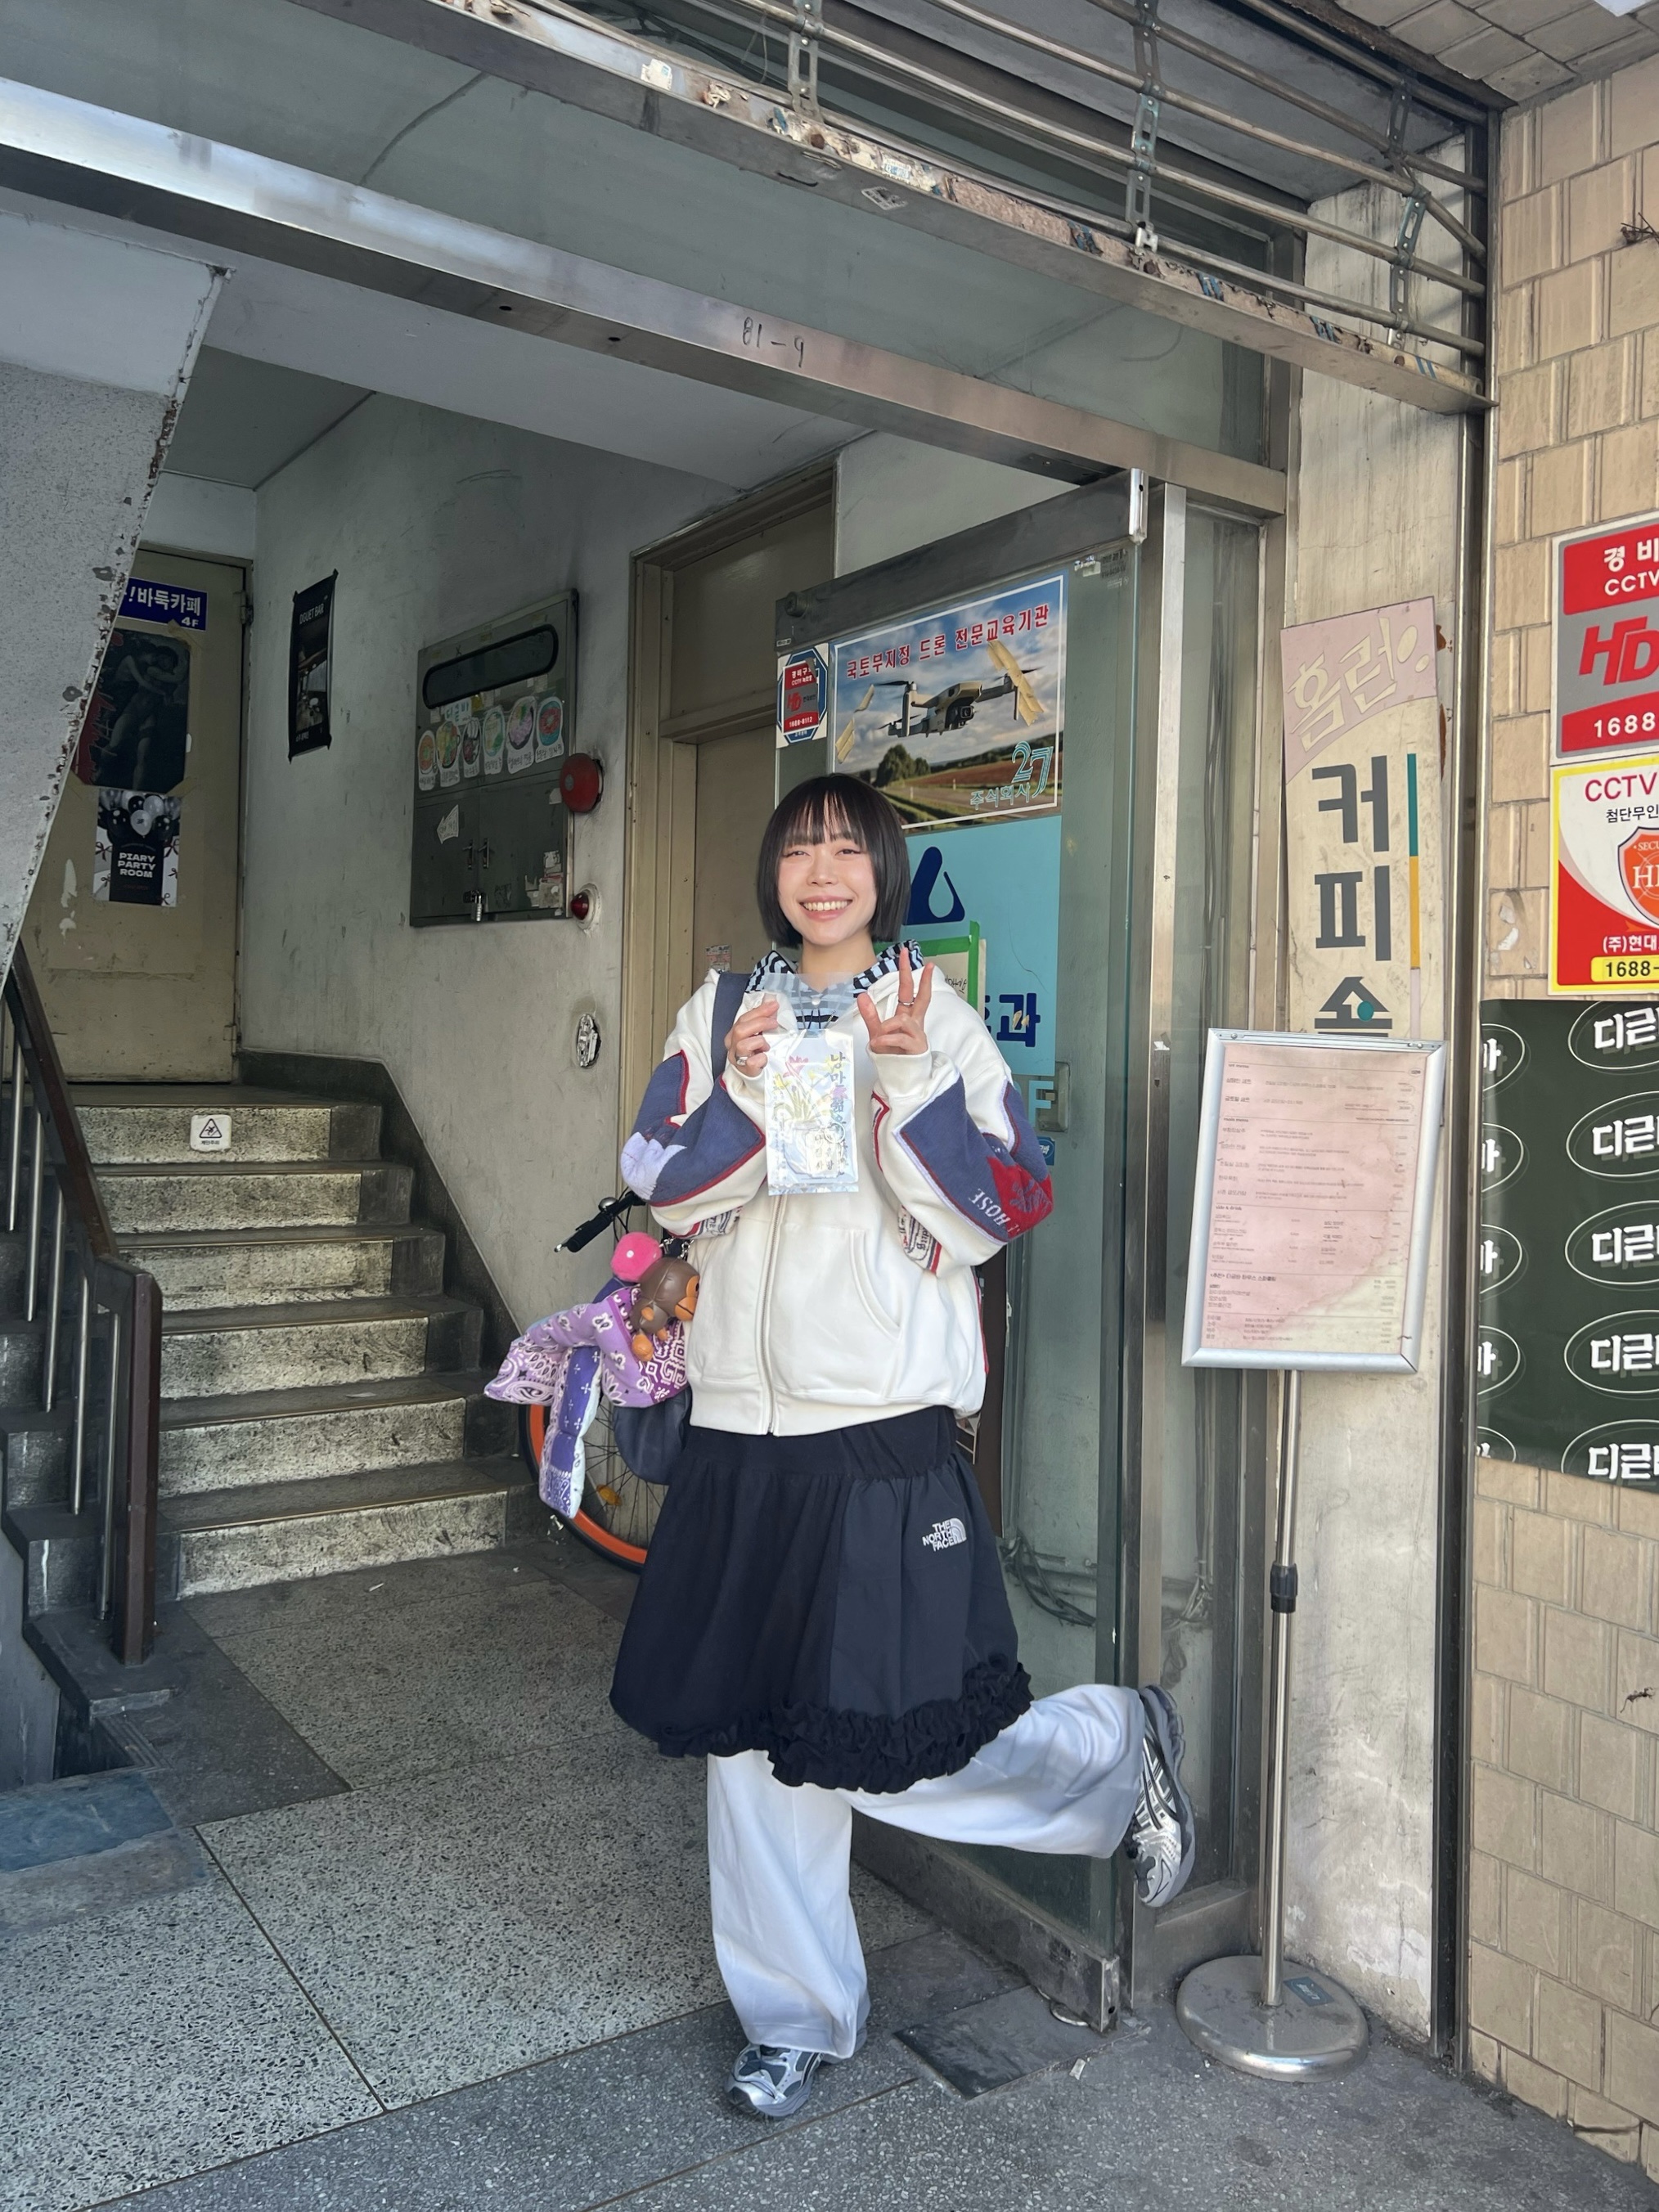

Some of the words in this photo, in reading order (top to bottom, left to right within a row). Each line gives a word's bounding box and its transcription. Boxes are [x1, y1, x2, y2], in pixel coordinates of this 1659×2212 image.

[1604, 569, 1659, 596] CCTV
[182, 617, 199, 627] 4F
[919, 634, 946, 660] 드론
[955, 604, 1050, 650] 전문교육기관
[1579, 615, 1659, 686] HD
[969, 782, 1031, 811] 주식회사
[1585, 772, 1657, 803] CCTV
[1606, 804, 1659, 823] 첨단무인
[117, 861, 156, 870] PARTY
[119, 852, 155, 862] PIARY
[119, 869, 153, 878] ROOM
[1632, 863, 1659, 889] H
[1603, 935, 1659, 954] (주)현대
[1594, 1006, 1659, 1050] 디귿
[1592, 1115, 1659, 1157] 디귿
[1591, 1224, 1659, 1265] 디귿
[1590, 1333, 1659, 1373] 디귿
[1588, 1443, 1659, 1480] 디귿
[922, 1528, 952, 1546] NORTH
[932, 1519, 951, 1533] THE
[933, 1538, 955, 1552] FACE
